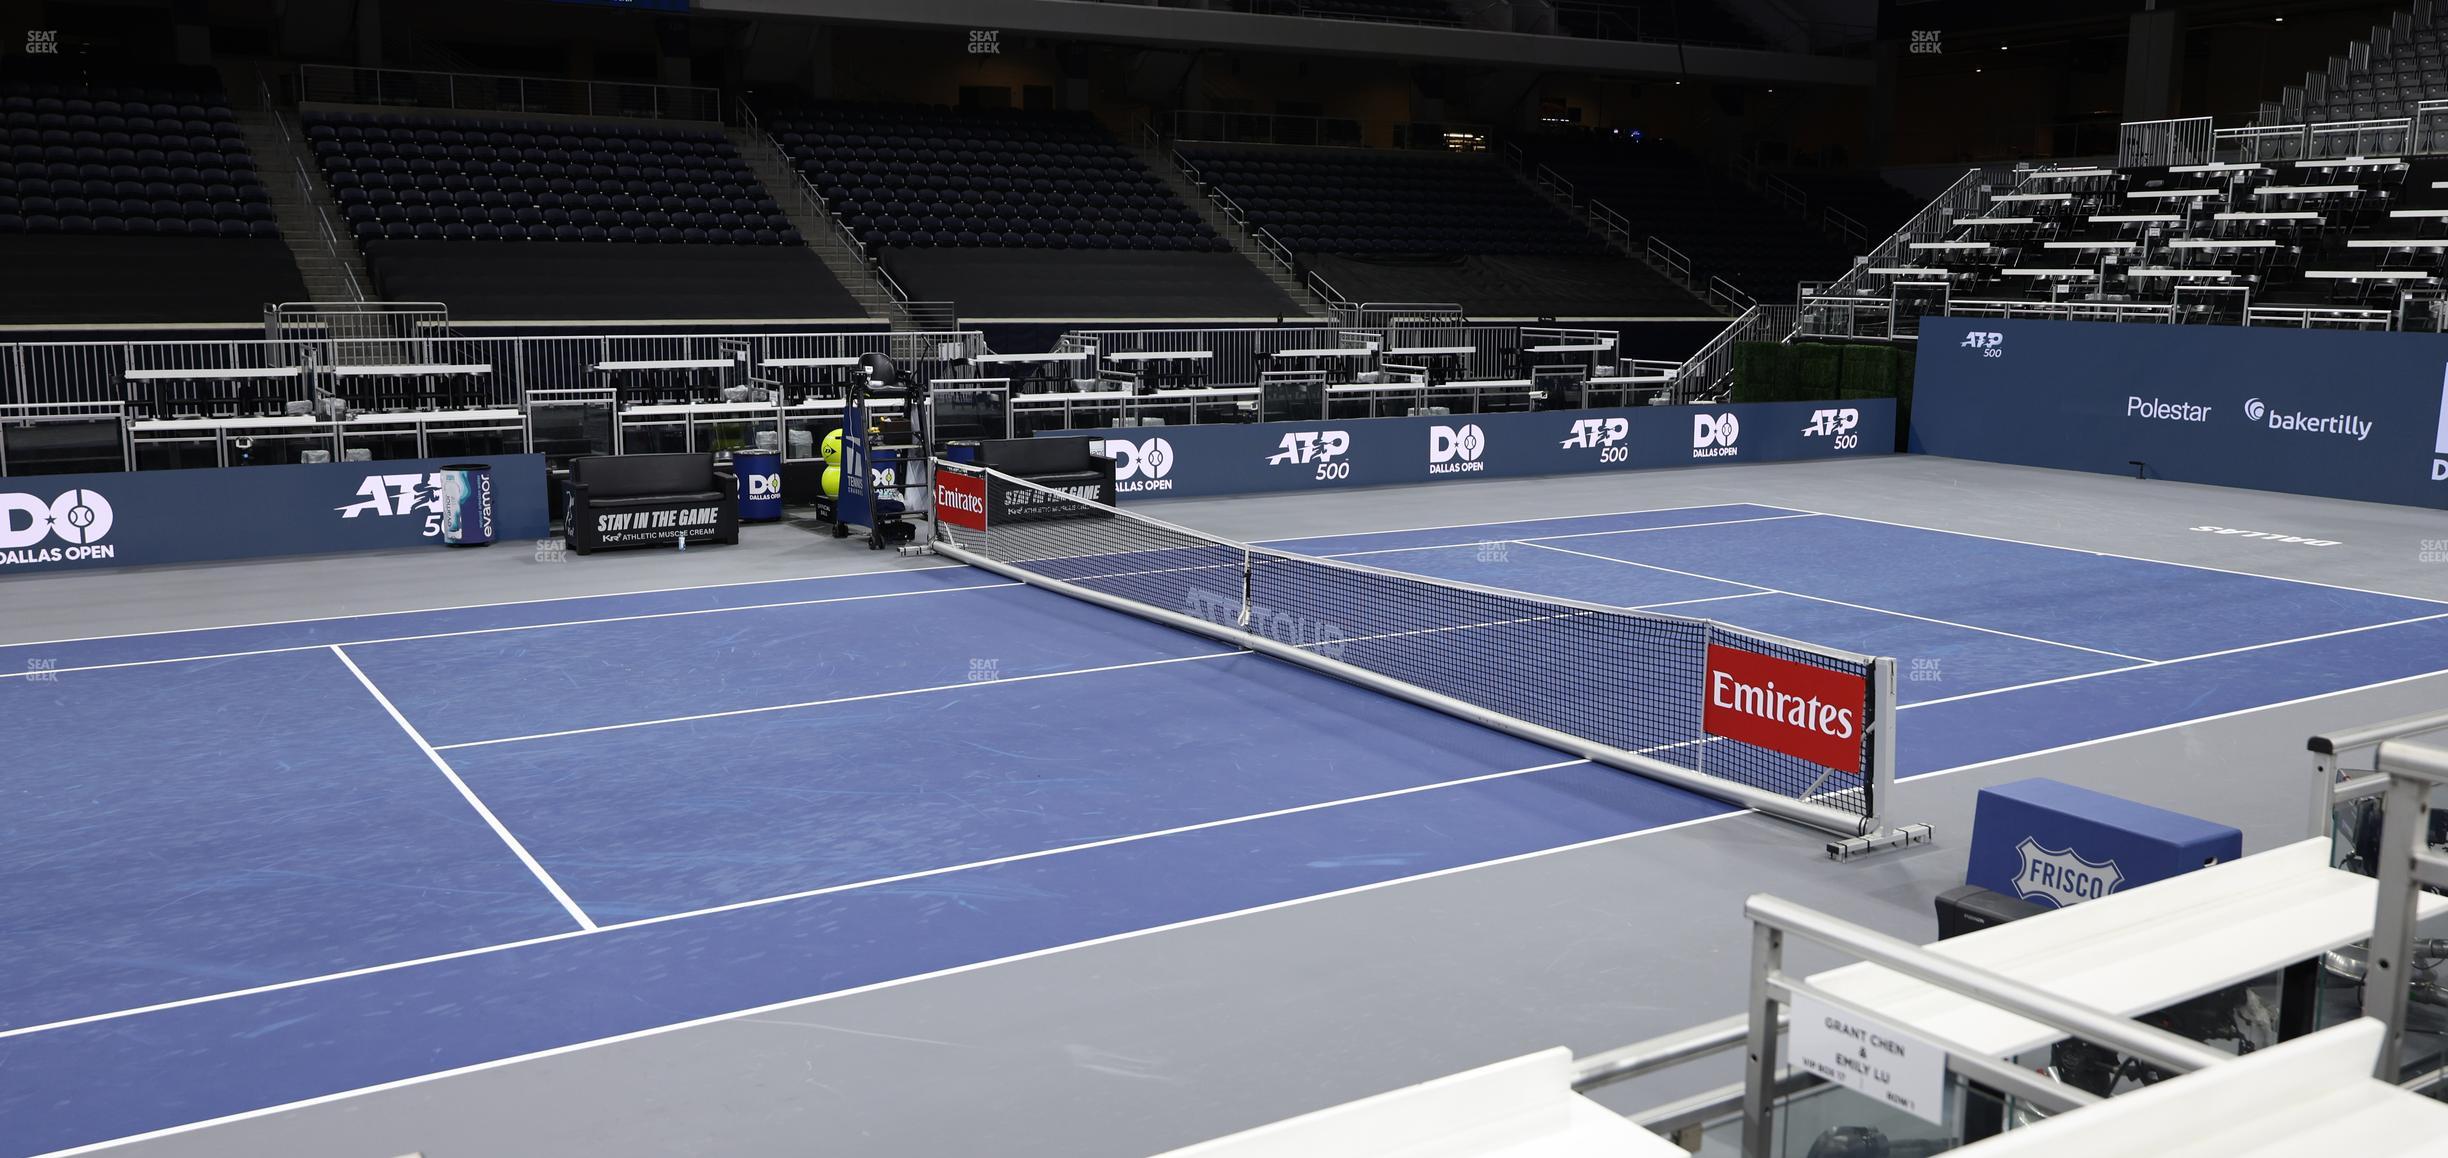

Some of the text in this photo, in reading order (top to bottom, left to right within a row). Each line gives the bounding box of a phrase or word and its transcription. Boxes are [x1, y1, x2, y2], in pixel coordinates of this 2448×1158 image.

[1960, 331, 2003, 348] ATP
[1983, 348, 2002, 358] 500
[2127, 396, 2212, 422] Polestar
[1800, 408, 1859, 437] ATP
[2268, 409, 2373, 441] bakertilly
[1559, 417, 1629, 449] ATP
[1833, 434, 1858, 450] 500
[1265, 430, 1350, 465] ATP
[1600, 446, 1628, 463] 500
[1693, 447, 1738, 458] DALLAS OPEN
[1315, 462, 1350, 480] 500
[1429, 461, 1484, 474] DALLAS OPEN
[1115, 480, 1172, 492] ALLAS OPEN
[481, 474, 492, 537] evamor
[938, 484, 983, 514] Emirates
[597, 507, 719, 532] STAY IN THE GAME
[622, 533, 657, 541] ATHLETIC
[659, 529, 688, 539] MUSCLE
[689, 527, 715, 536] CREAM
[65, 544, 115, 561] OPEN
[1712, 669, 1853, 740] Emirates
[2029, 858, 2103, 900] FRISCO
[1824, 1016, 1905, 1057] GRANT CHEN
[1859, 1047, 1866, 1057] &
[1818, 1063, 1835, 1077] BOX
[1835, 1053, 1890, 1085] EMILY LU
[1886, 1091, 1908, 1109] ROW
